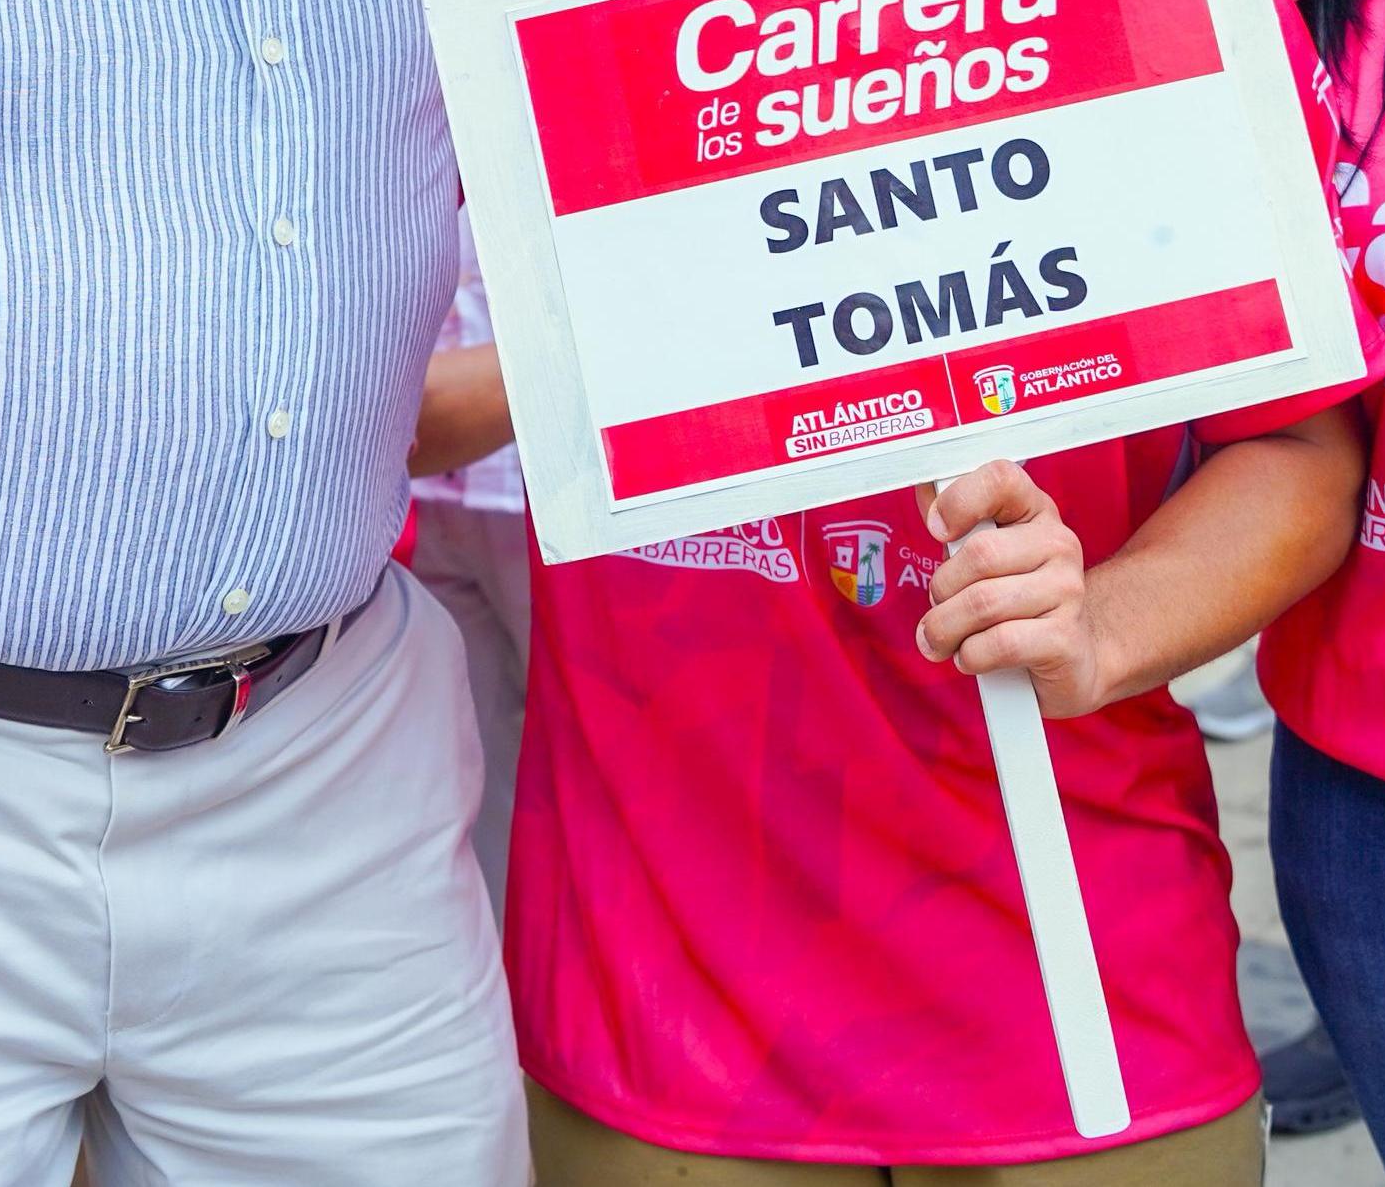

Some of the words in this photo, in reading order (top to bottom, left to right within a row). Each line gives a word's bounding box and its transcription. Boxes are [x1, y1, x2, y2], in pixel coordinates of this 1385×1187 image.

[696, 131, 743, 163] los
[755, 36, 1051, 149] sueños
[696, 97, 741, 132] de
[759, 137, 1051, 254] SANTO
[772, 239, 1089, 369] TOMÁS
[1019, 357, 1095, 382] GOBERNACIÓN
[1096, 353, 1119, 365] DEL
[1023, 362, 1123, 398] ATLÁNTICO
[791, 389, 924, 436] ATLÁNTICO
